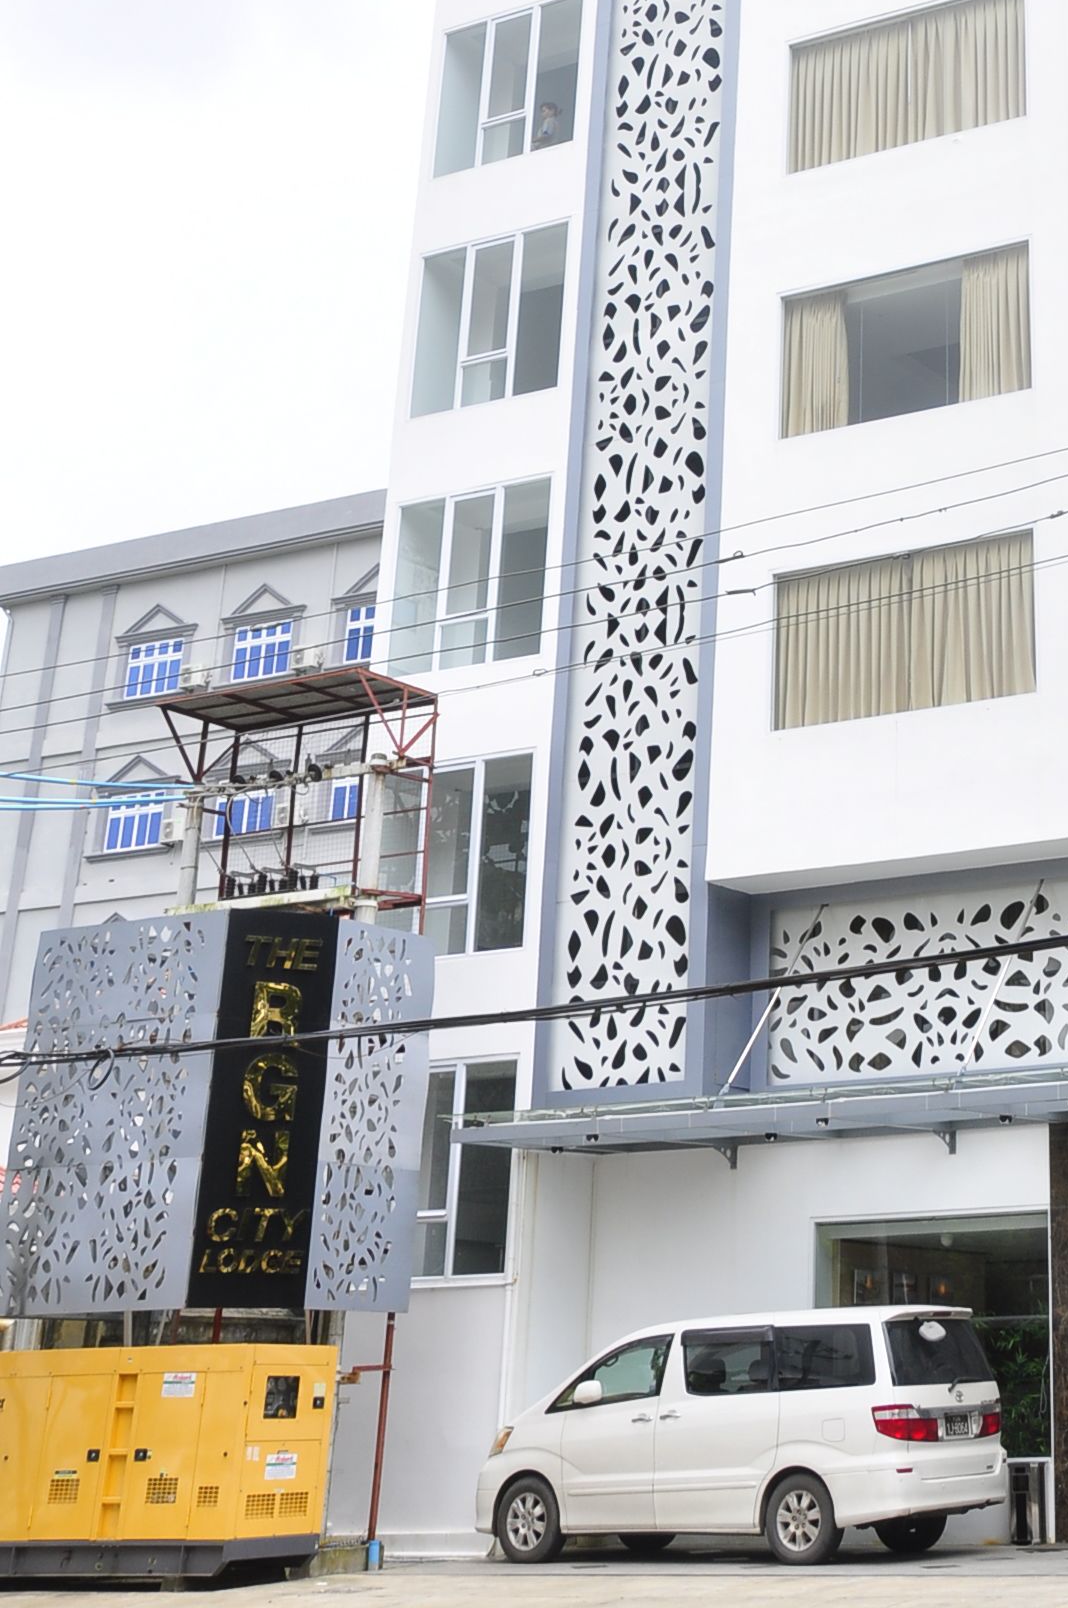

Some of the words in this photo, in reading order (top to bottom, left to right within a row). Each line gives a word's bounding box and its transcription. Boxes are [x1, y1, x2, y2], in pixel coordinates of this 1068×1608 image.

[244, 935, 324, 971] THE
[234, 981, 302, 1198] RGN
[208, 1207, 311, 1242] CITY
[198, 1248, 304, 1274] LODGE
